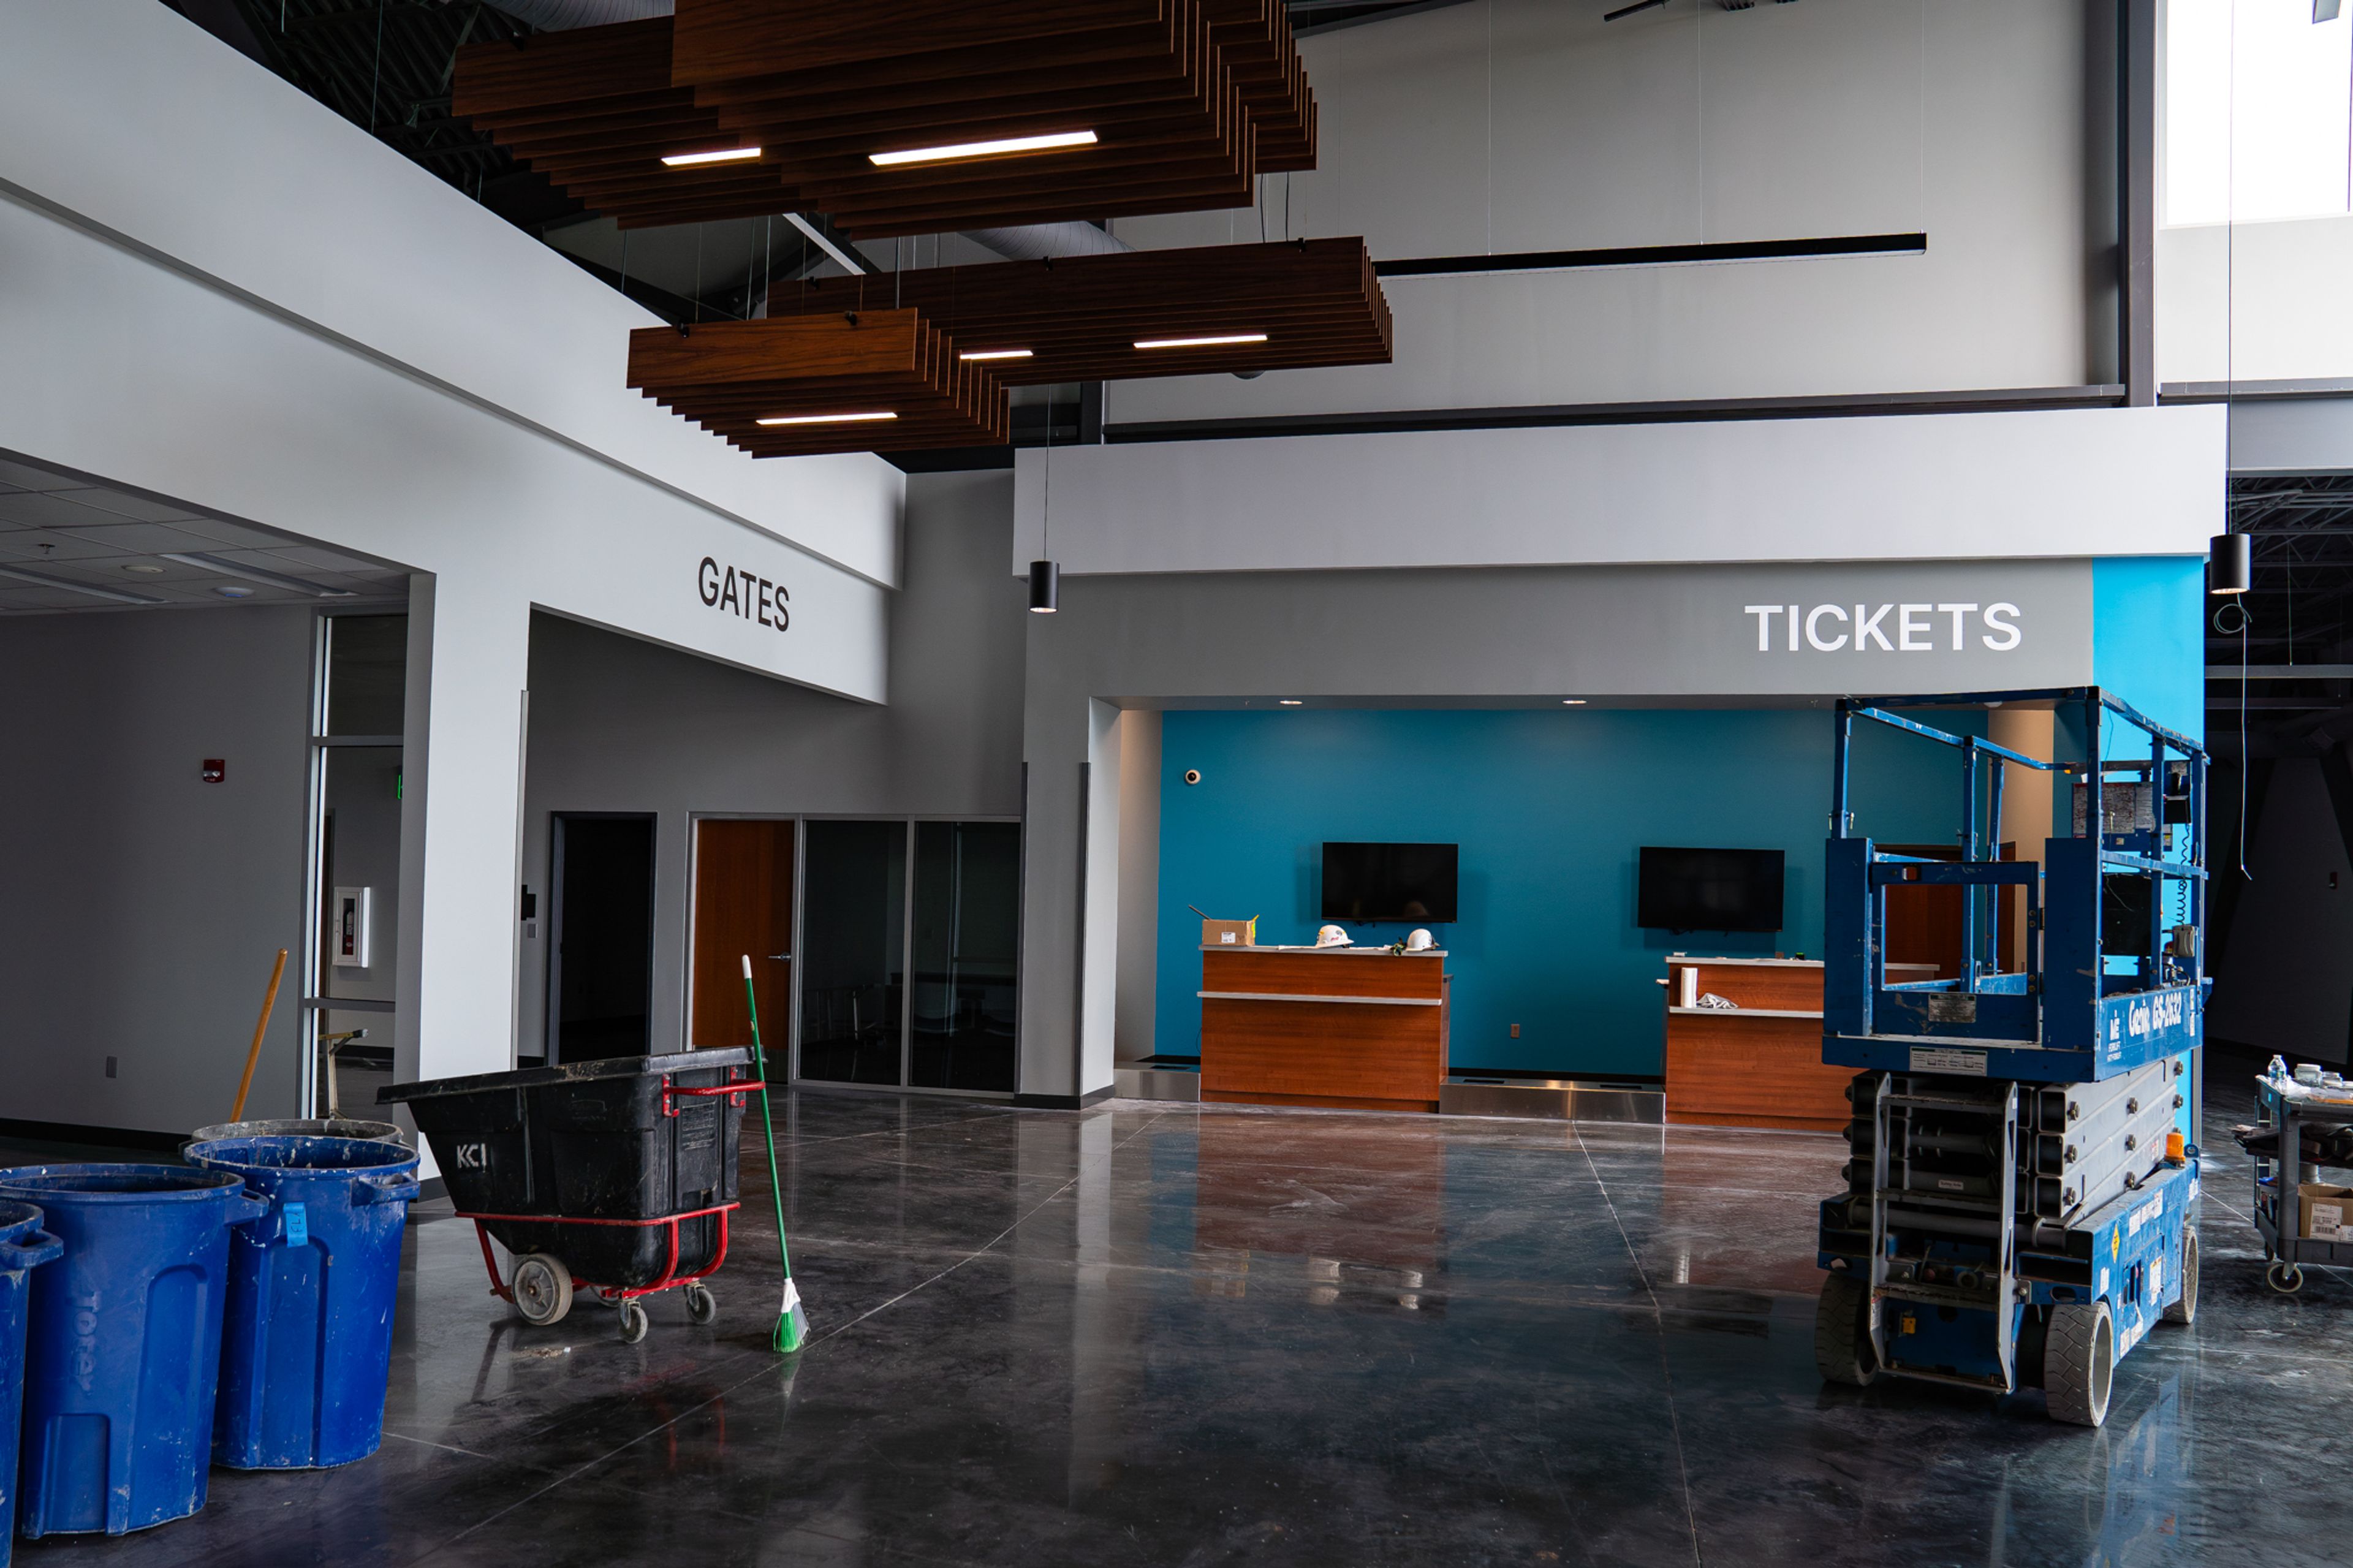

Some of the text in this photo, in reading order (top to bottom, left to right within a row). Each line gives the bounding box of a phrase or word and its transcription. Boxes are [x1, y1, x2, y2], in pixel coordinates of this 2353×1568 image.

[699, 556, 789, 632] GATES
[1745, 602, 2021, 651] TICKETS
[2129, 999, 2150, 1037] Genie
[457, 1143, 487, 1168] KCI
